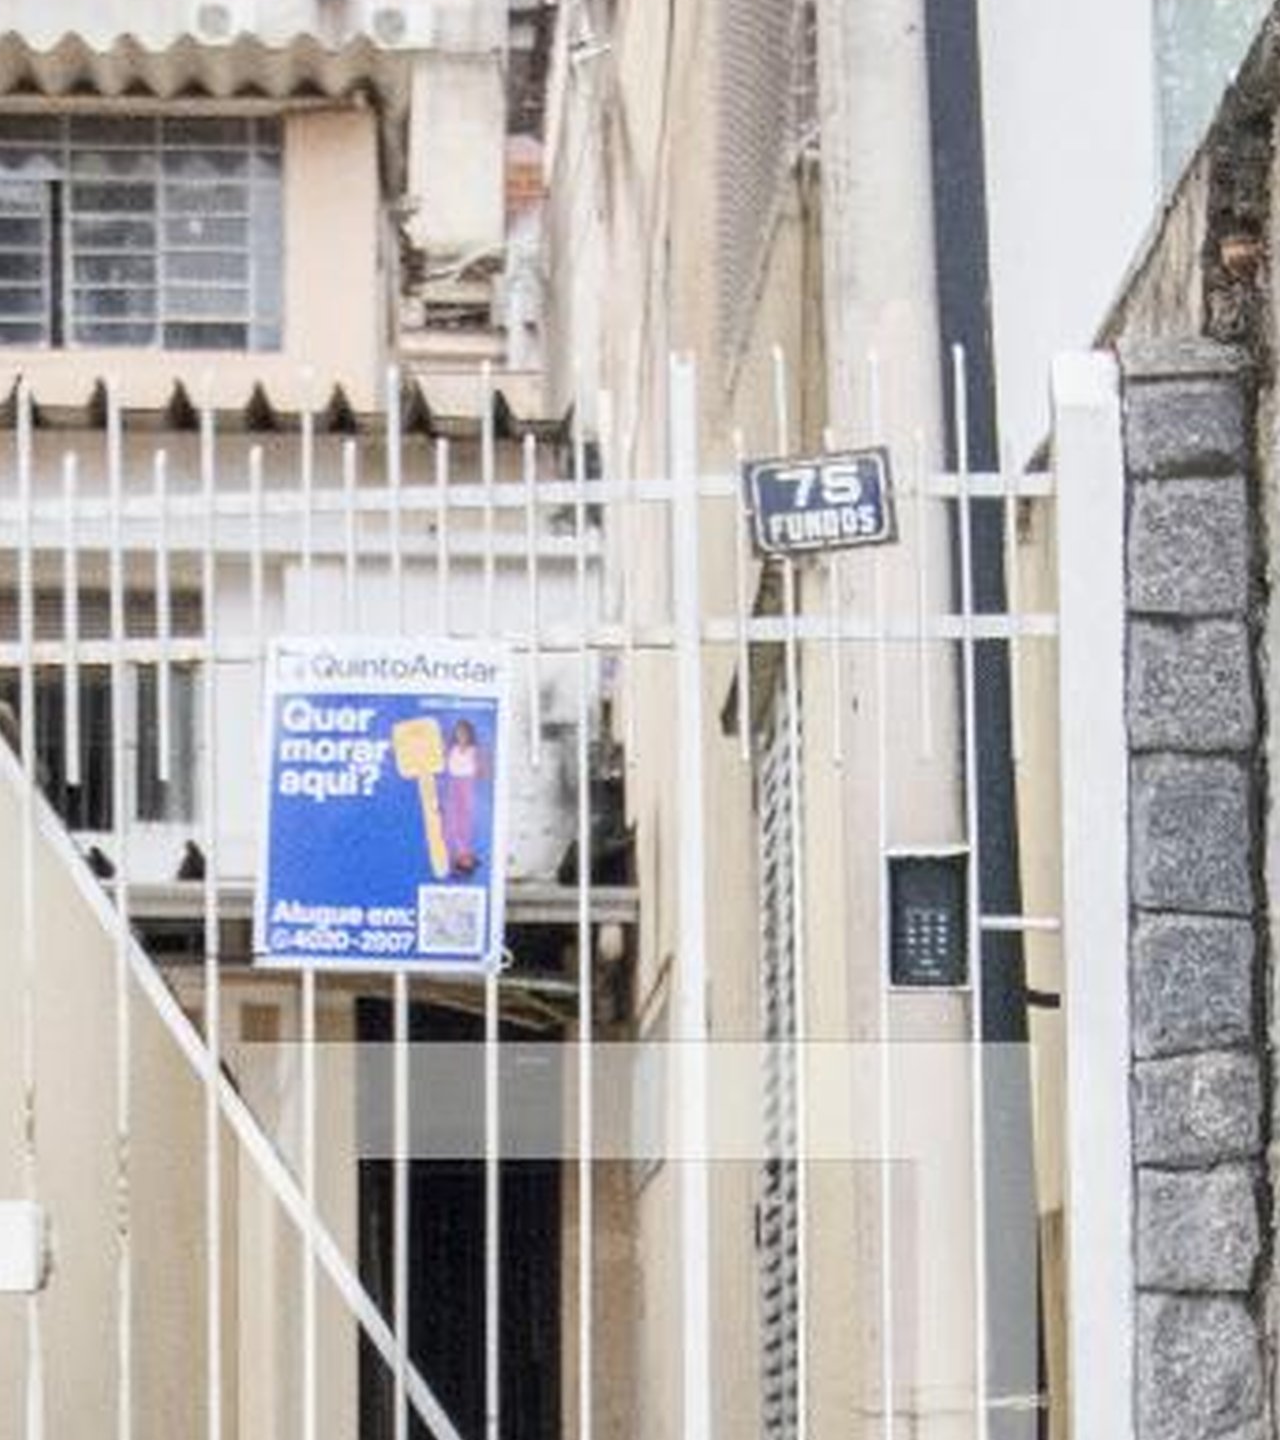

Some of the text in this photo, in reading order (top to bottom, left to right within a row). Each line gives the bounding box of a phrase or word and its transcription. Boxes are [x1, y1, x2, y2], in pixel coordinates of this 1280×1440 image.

[775, 463, 862, 508] 75
[770, 504, 876, 544] FUNDOS
[312, 650, 498, 684] QuintoAndar
[281, 699, 376, 732] Quer
[279, 736, 391, 764] morar
[278, 764, 380, 801] aqui?
